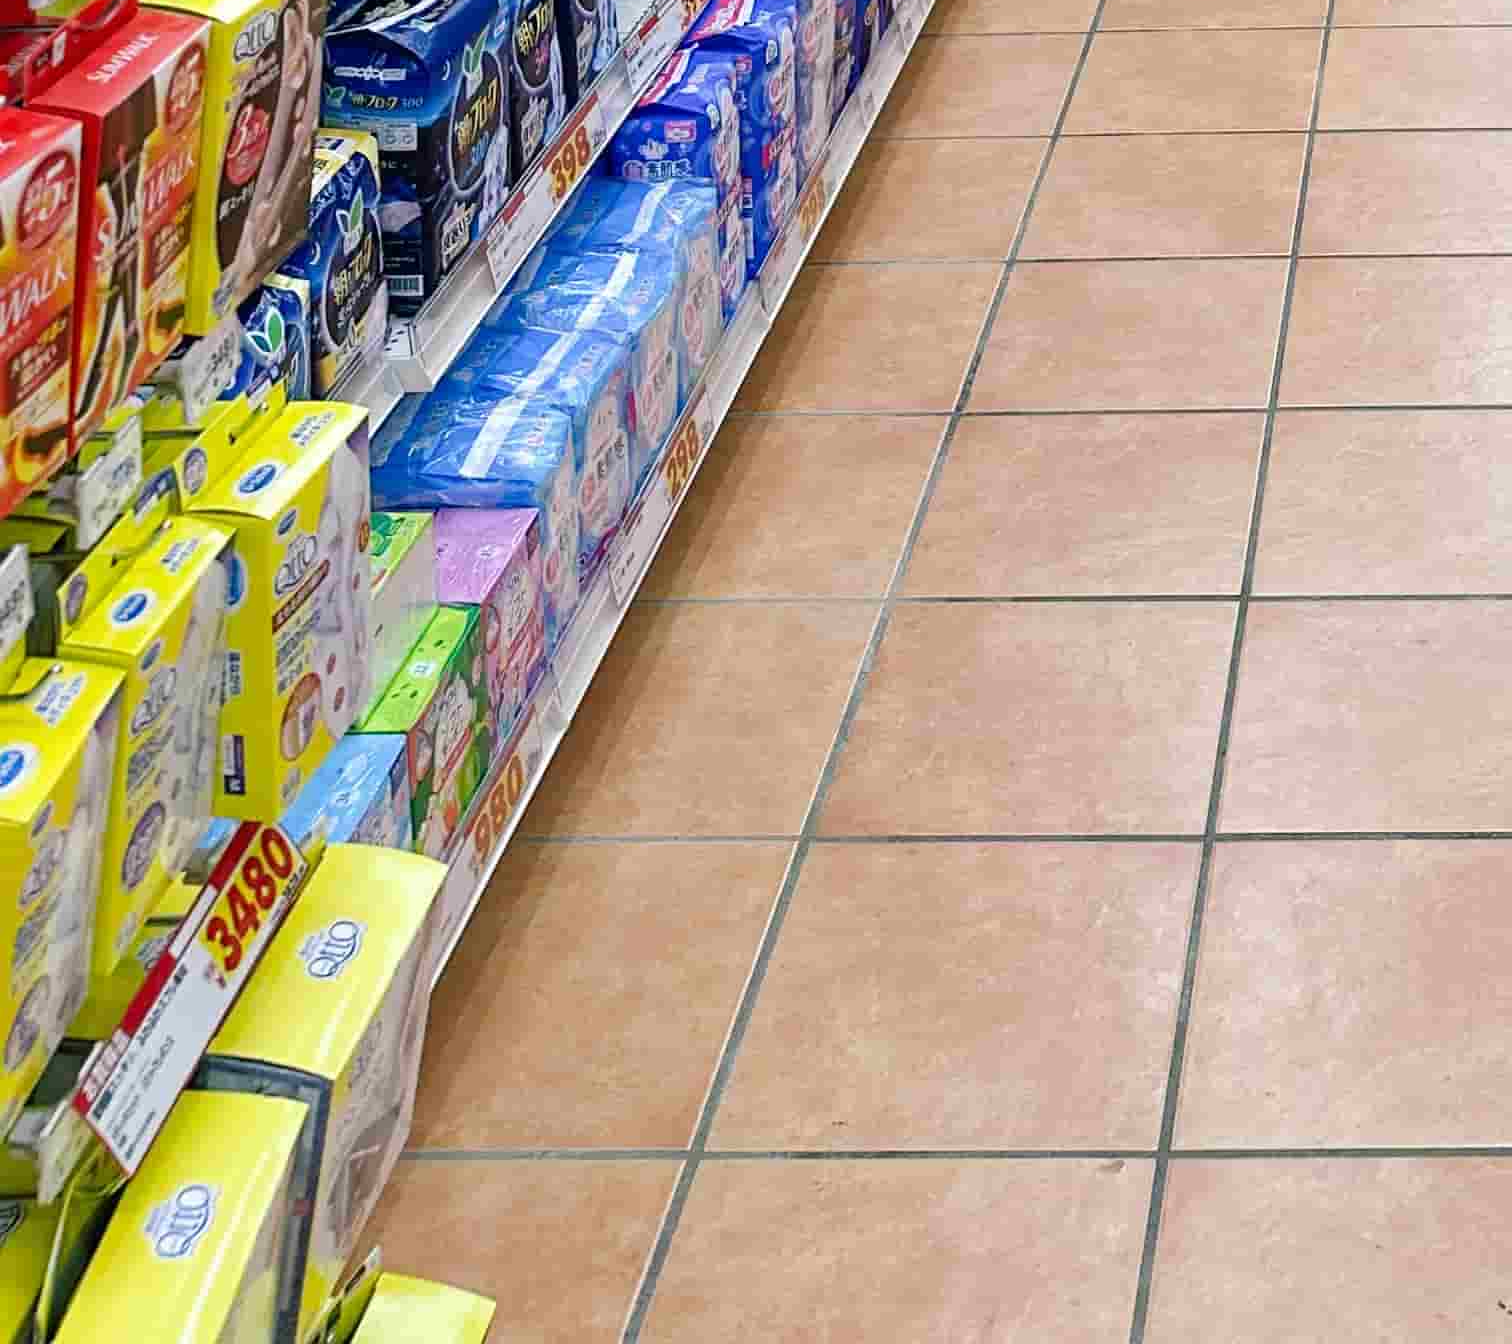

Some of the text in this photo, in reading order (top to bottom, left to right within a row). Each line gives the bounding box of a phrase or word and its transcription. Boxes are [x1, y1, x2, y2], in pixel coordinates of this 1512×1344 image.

[552, 128, 591, 198] 398
[473, 752, 523, 863] 980
[206, 826, 293, 972] 3480
